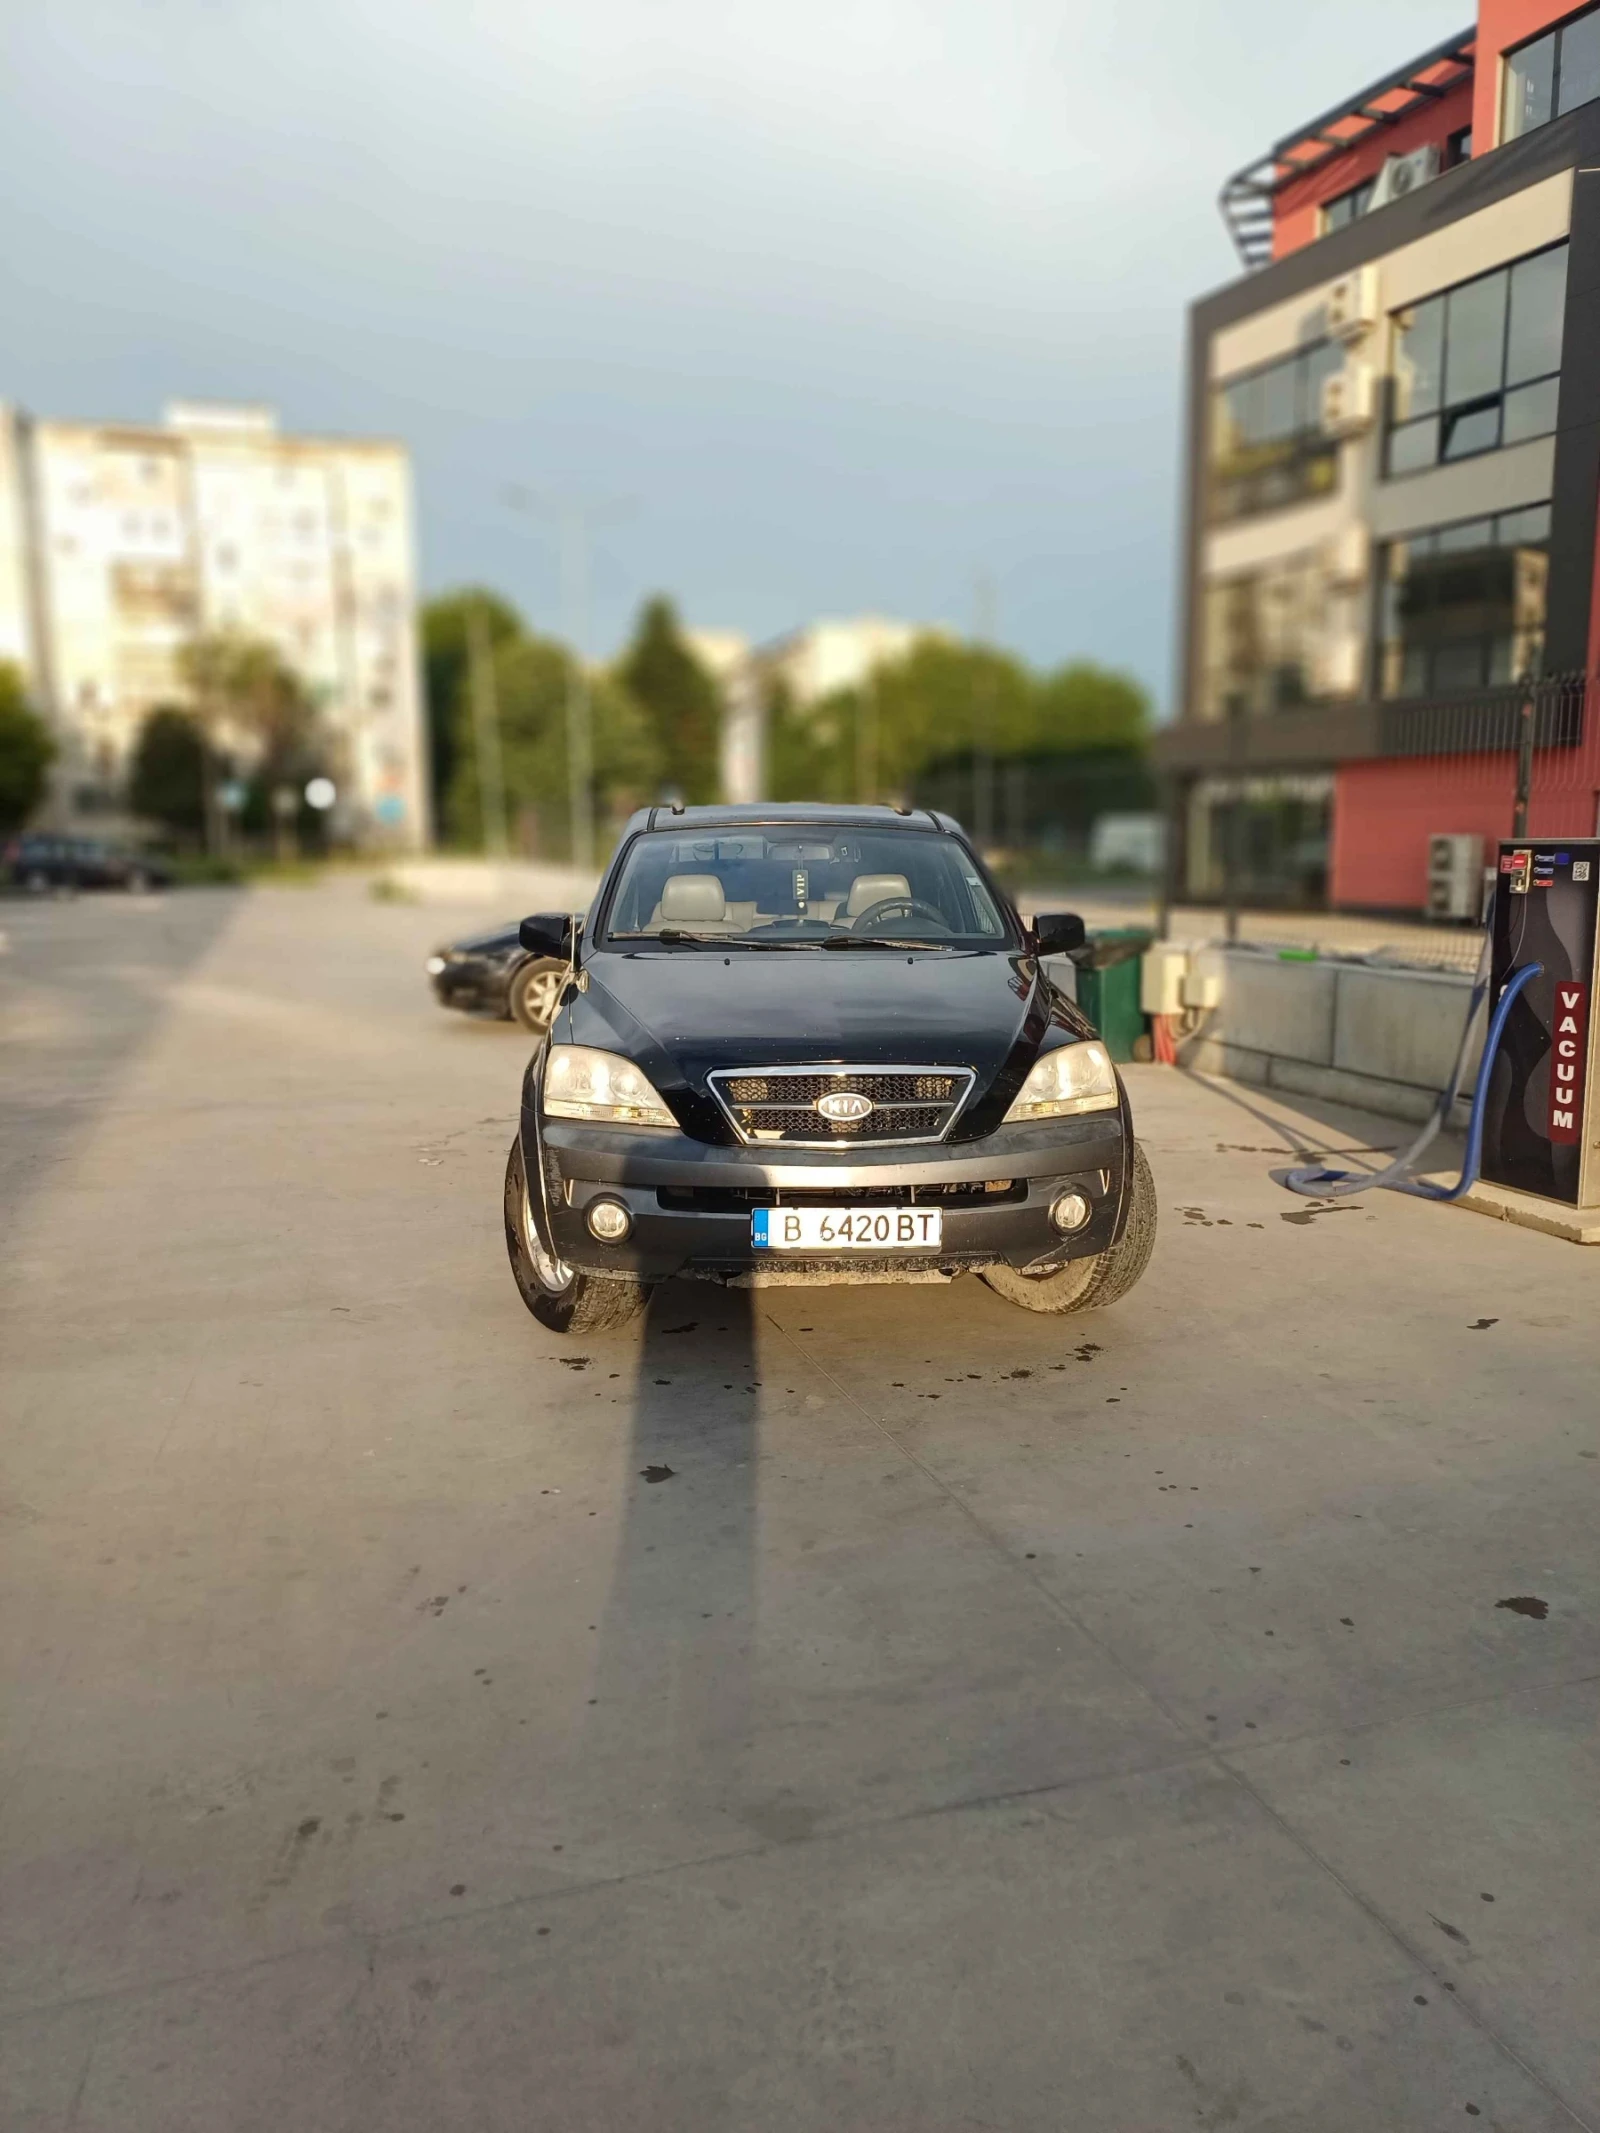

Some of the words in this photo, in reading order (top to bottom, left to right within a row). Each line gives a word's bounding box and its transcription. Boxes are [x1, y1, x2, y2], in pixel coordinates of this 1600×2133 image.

[796, 874, 805, 896] VIP
[1552, 991, 1580, 1129] VACUUM
[827, 1099, 864, 1114] KIA
[754, 1231, 767, 1241] BG
[784, 1215, 802, 1242] B
[819, 1215, 890, 1242] 6420
[897, 1214, 934, 1242] BT
